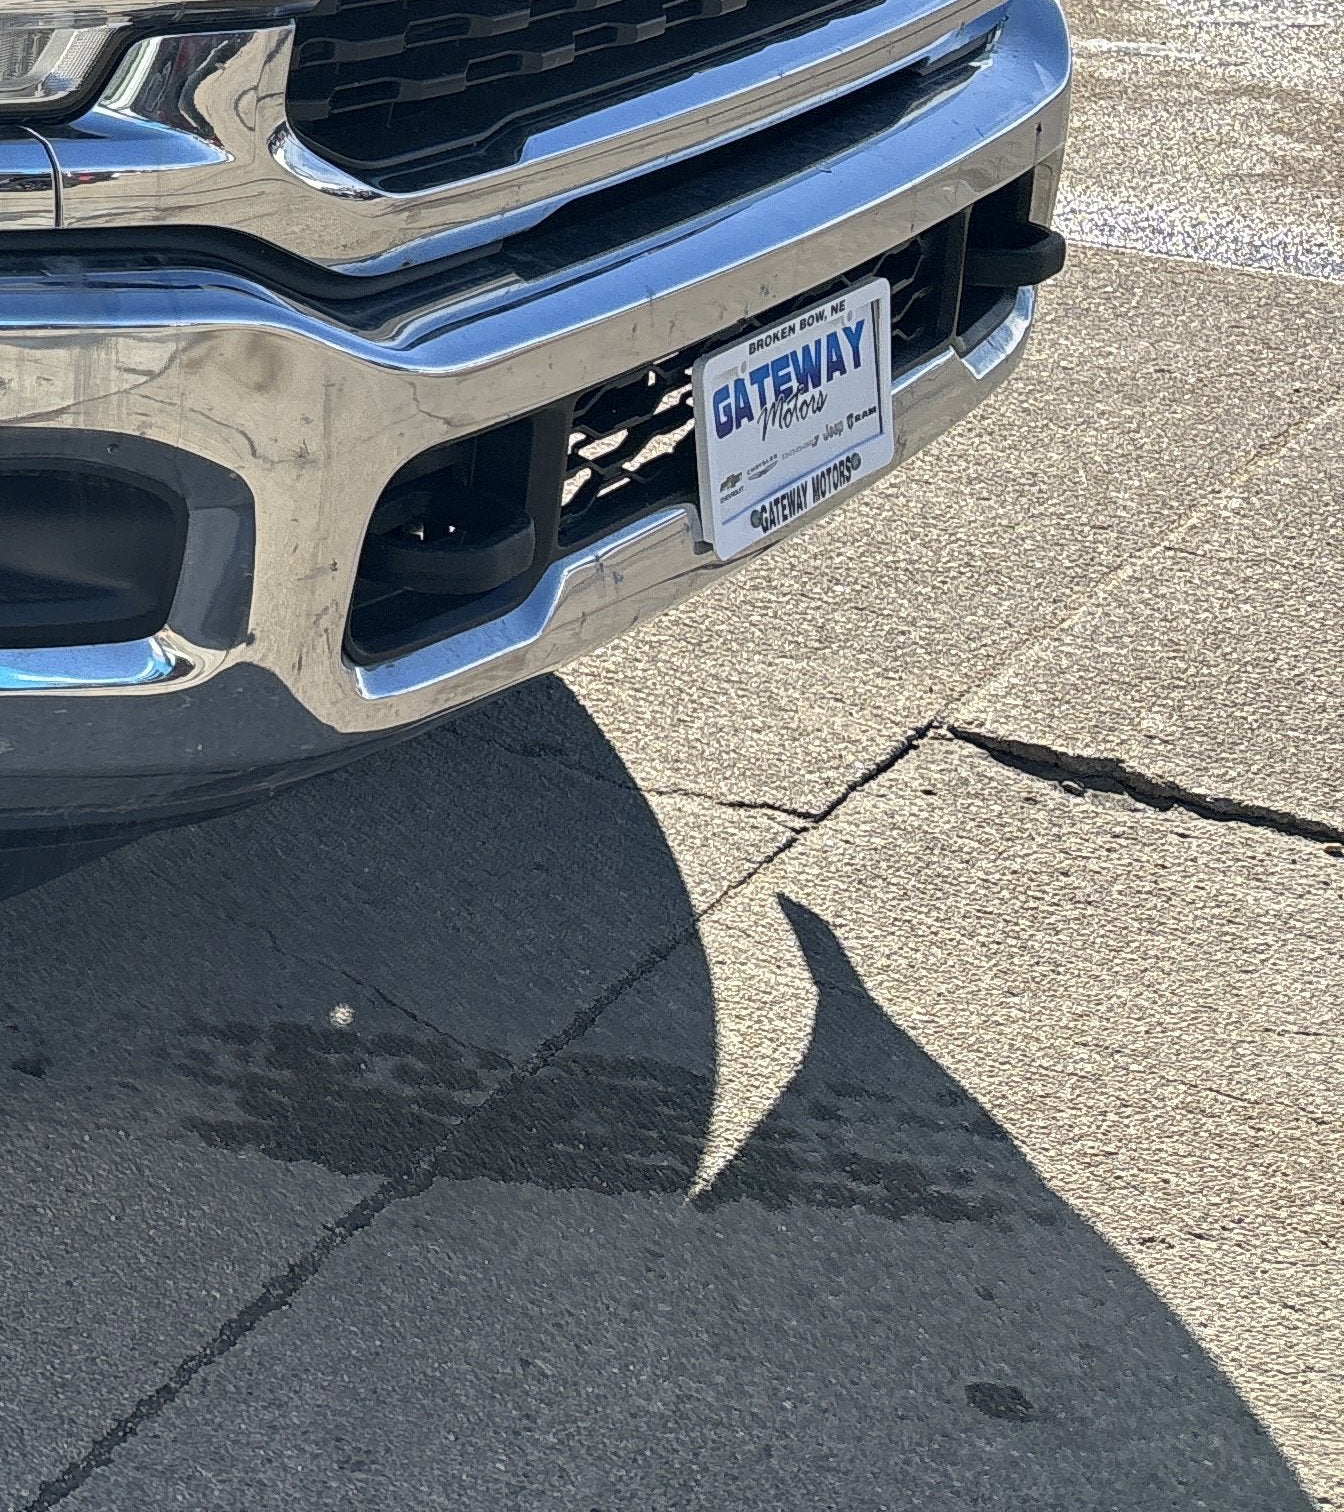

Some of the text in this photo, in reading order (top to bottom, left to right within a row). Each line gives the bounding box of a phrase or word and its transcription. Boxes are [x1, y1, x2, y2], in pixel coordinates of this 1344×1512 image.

[749, 300, 846, 356] BROKEN BOW, NE
[712, 319, 866, 439] GATEWAY
[757, 384, 828, 441] Motors
[761, 455, 853, 534] GATEWAY MOTORS
